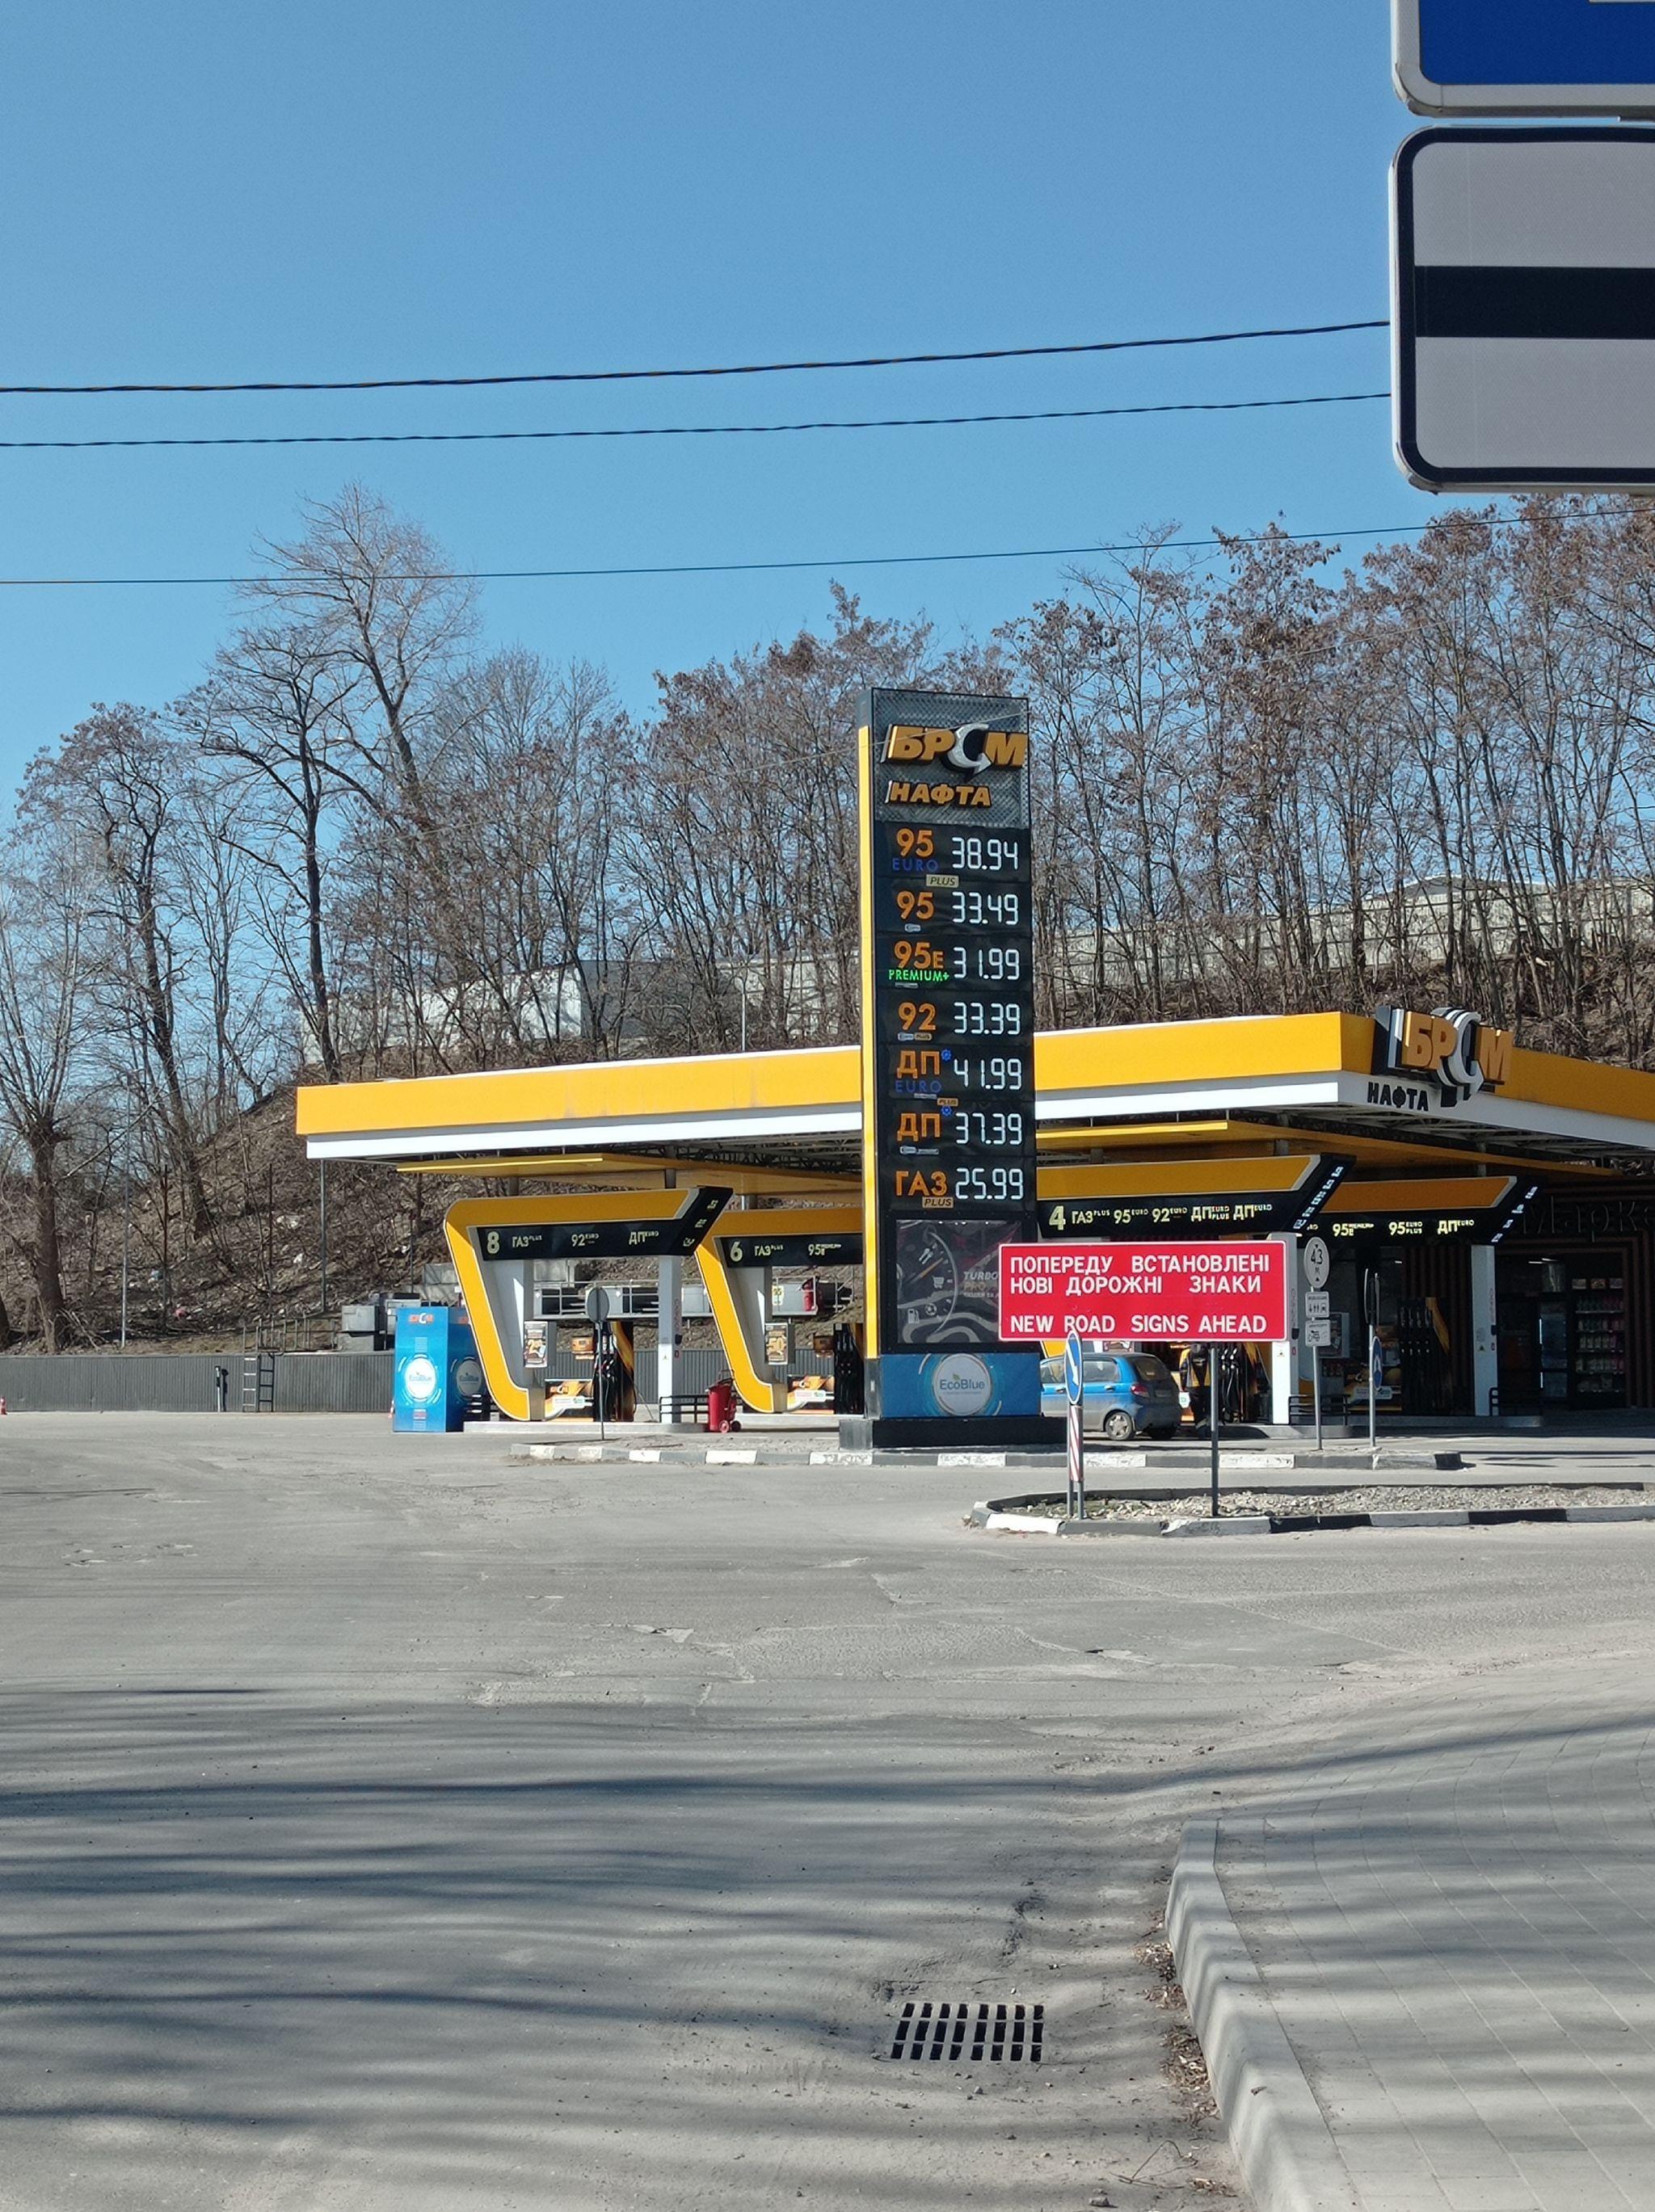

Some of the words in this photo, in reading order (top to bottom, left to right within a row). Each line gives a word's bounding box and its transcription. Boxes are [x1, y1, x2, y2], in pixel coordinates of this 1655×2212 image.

[887, 723, 1028, 768] БРСМ
[890, 781, 992, 807] НАФТА
[896, 828, 934, 857] 95
[952, 837, 1018, 870] 38.94
[892, 858, 939, 872] EURO
[929, 877, 957, 886] PLUS
[896, 891, 934, 919] 95
[952, 891, 1019, 925] 33.49
[889, 969, 950, 982] PREMIUM+
[953, 947, 1021, 980] 31.99
[898, 1003, 936, 1031] 92
[954, 1002, 1021, 1035] 33.39
[1402, 1010, 1513, 1091] БРСМ
[896, 1050, 941, 1079] ДП
[953, 1058, 1022, 1090] 41.99
[895, 1080, 941, 1093] EURO
[1367, 1082, 1429, 1112] НАФТА
[897, 1113, 941, 1142] ДП
[955, 1112, 1022, 1145] 37.39
[895, 1171, 947, 1196] ГАЗ
[955, 1167, 1023, 1200] 25.99
[924, 1198, 953, 1208] PLUS
[1049, 1205, 1066, 1230] 4
[1072, 1210, 1093, 1224] ГАЗ
[1114, 1209, 1131, 1224] 95
[1152, 1208, 1170, 1223] 92
[1191, 1206, 1212, 1222] ДП
[1233, 1205, 1254, 1220] ДП
[1388, 1222, 1406, 1236] 95
[1437, 1220, 1458, 1234] ДП
[486, 1231, 500, 1254] 8
[512, 1237, 529, 1248] ГАЗ
[571, 1234, 586, 1247] 92
[629, 1231, 646, 1245] ДП
[730, 1241, 743, 1262] 6
[755, 1245, 771, 1256] ГАЗ
[1011, 1256, 1113, 1275] ПОПЕРЕДУ
[1132, 1255, 1270, 1273] ВСТАНОВЛЕНІ
[1011, 1276, 1051, 1293] НОВІ
[1066, 1276, 1161, 1296] ДОРОЖНІ
[1189, 1275, 1261, 1293] ЗНАКИ
[1011, 1315, 1054, 1333] NEW
[1064, 1314, 1115, 1333] ROAD
[1131, 1314, 1190, 1333] SIGNS
[1199, 1315, 1267, 1333] AHEAD
[940, 1379, 985, 1390] EcoBlue
